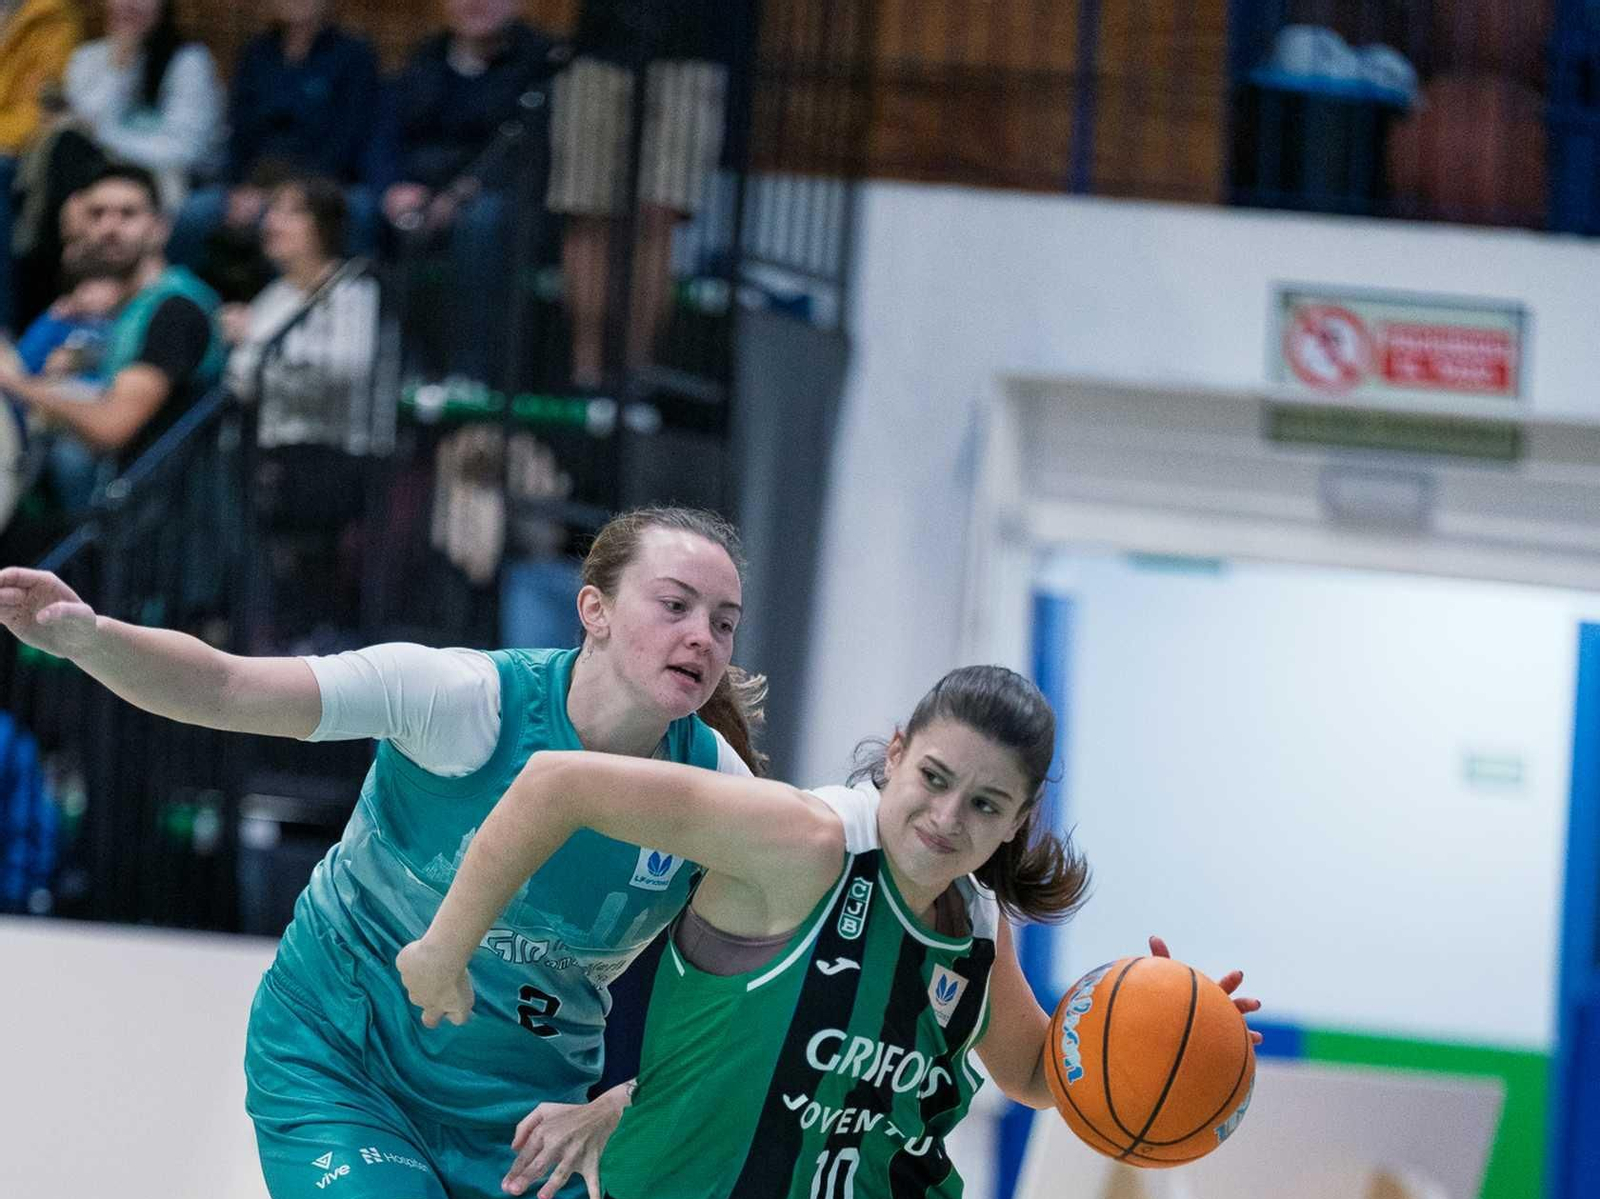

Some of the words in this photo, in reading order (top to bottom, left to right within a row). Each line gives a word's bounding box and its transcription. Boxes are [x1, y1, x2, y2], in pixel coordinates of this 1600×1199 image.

[517, 983, 562, 1039] 2
[783, 1093, 943, 1159] JOVENTU
[315, 1164, 350, 1189] vive
